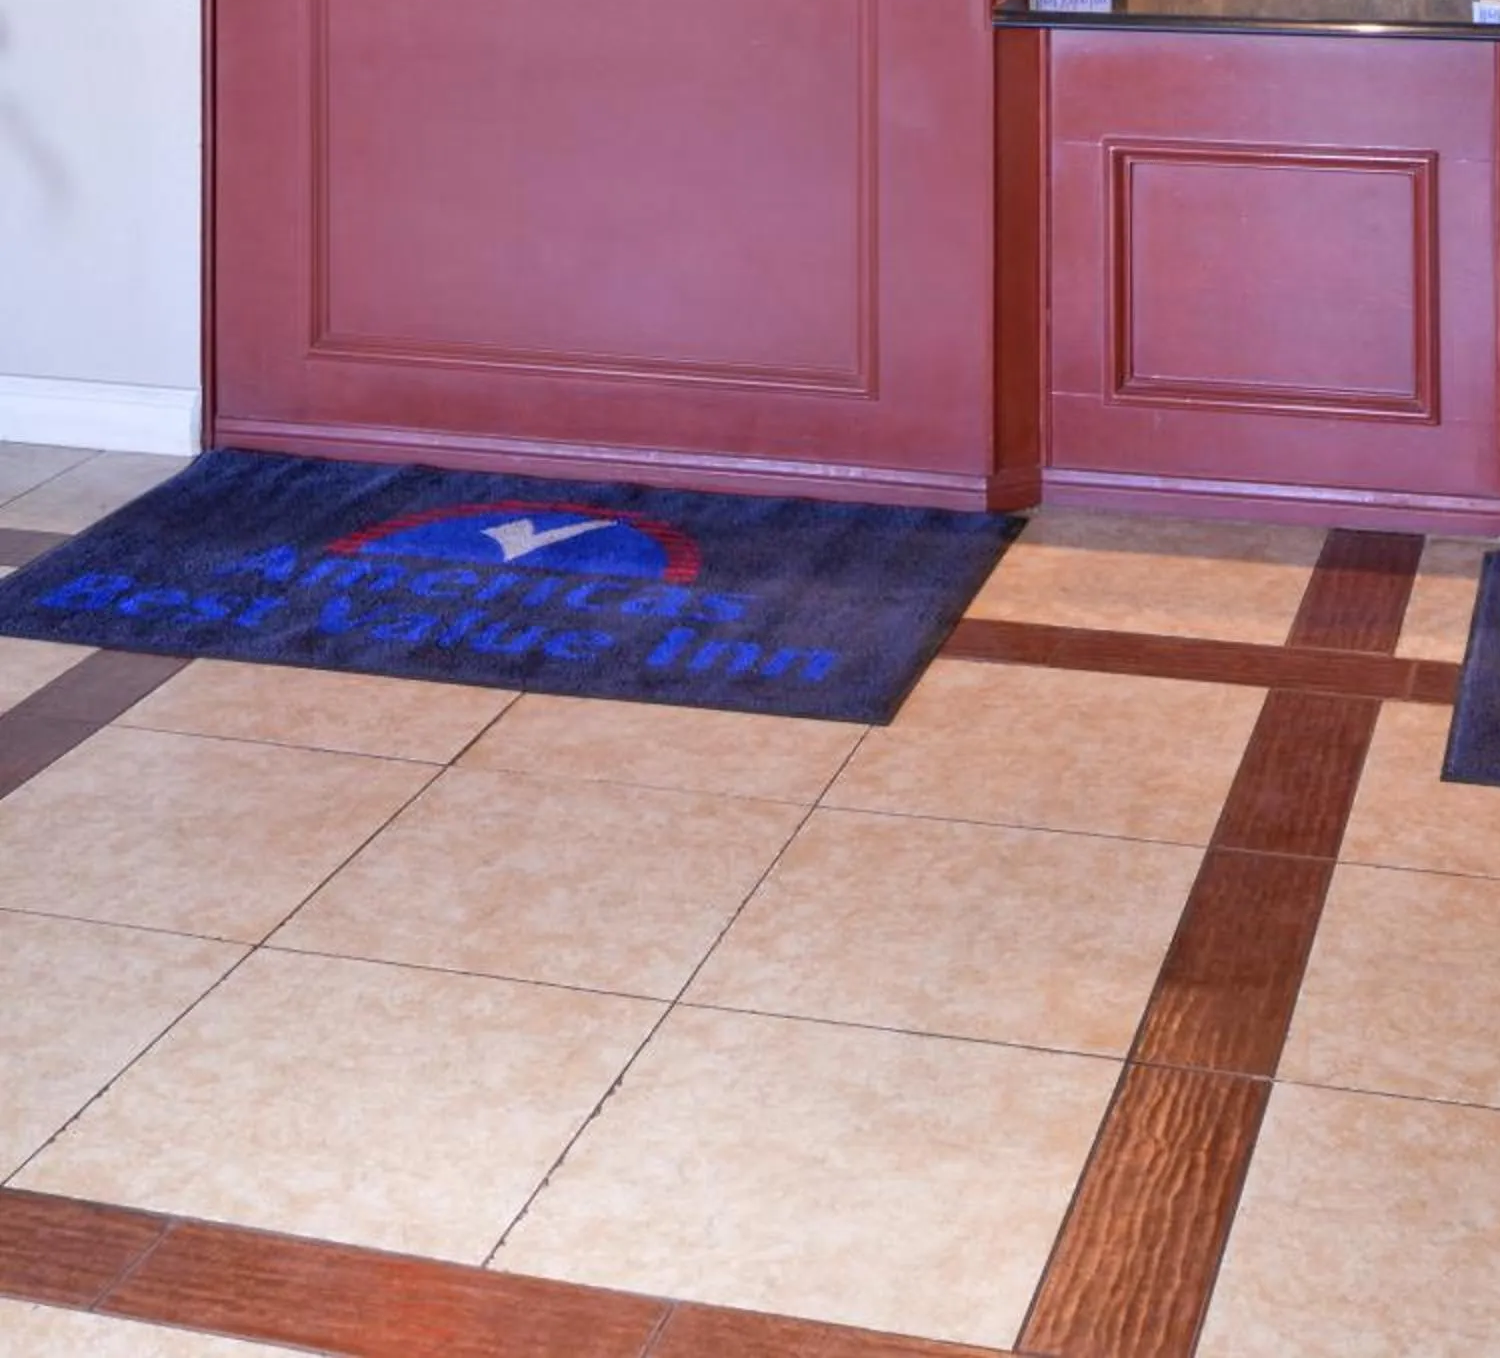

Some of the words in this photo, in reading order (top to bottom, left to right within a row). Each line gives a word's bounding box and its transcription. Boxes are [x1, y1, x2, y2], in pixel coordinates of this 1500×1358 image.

[37, 572, 290, 629] Best
[318, 594, 614, 661] Value
[645, 627, 838, 683] Inn
